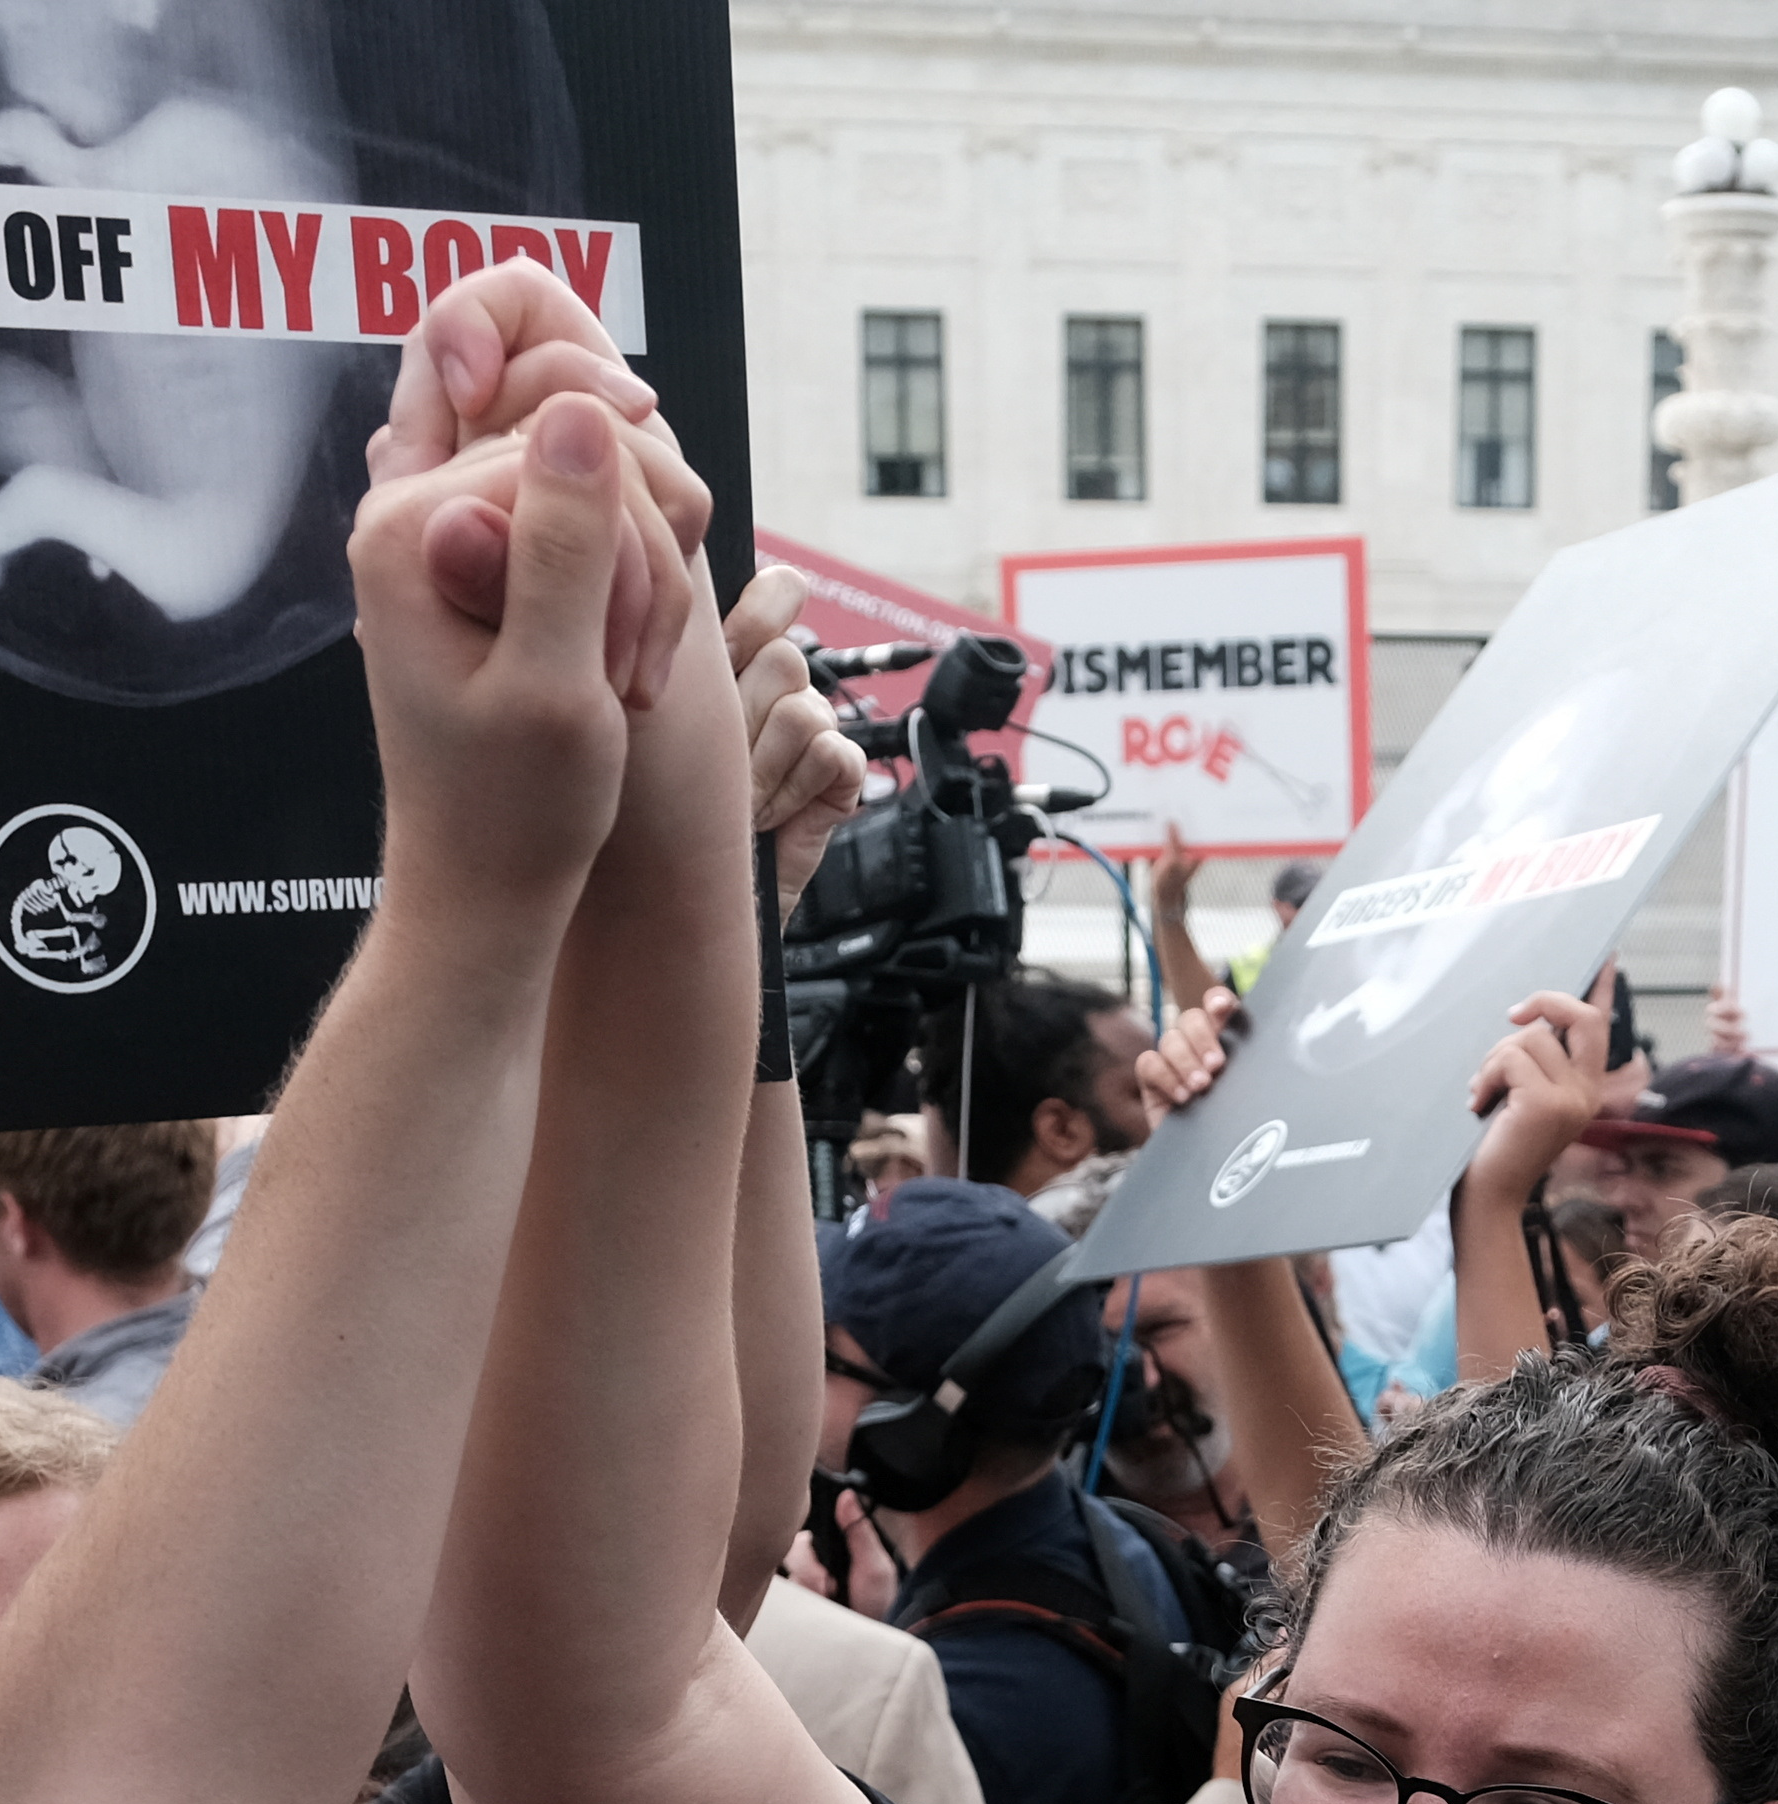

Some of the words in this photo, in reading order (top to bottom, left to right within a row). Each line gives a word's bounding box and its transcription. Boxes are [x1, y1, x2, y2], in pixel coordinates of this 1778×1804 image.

[5, 211, 133, 303] OFF
[167, 204, 322, 332] MY
[1046, 638, 1335, 694] ISMEMBER
